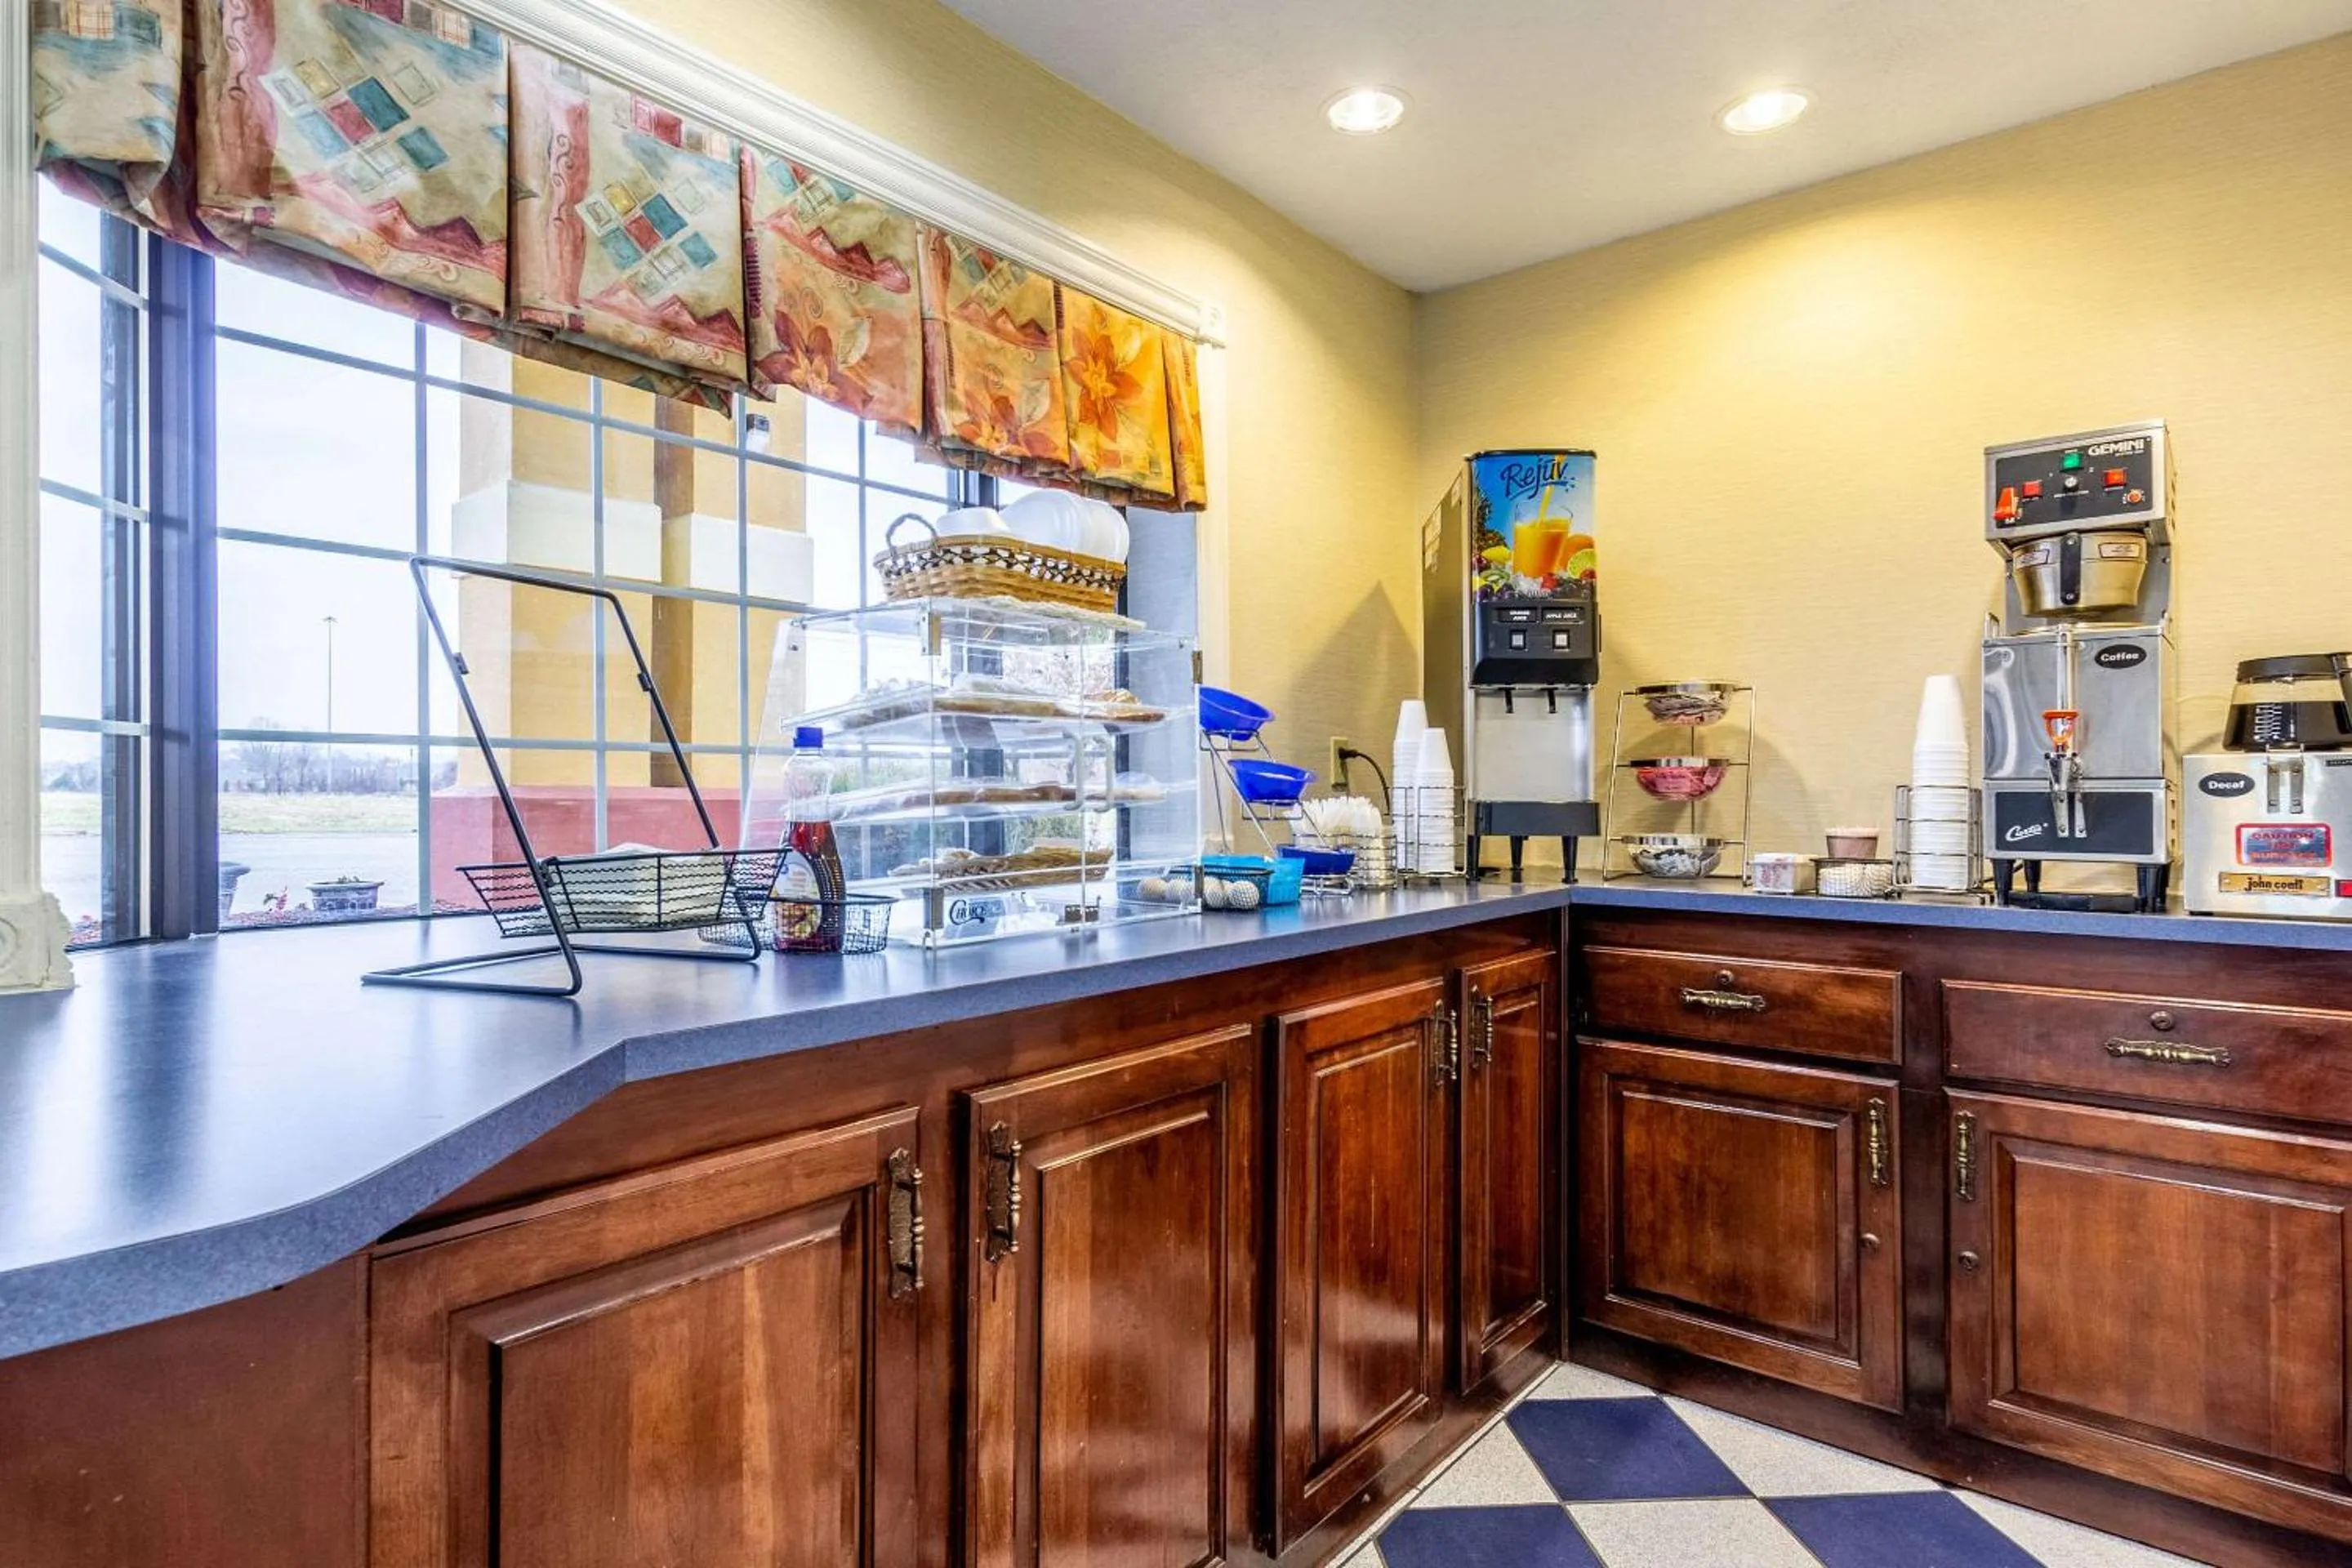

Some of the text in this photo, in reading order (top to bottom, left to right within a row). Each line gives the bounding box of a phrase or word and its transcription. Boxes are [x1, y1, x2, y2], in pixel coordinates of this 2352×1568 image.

[2087, 439, 2145, 456] GEMINI
[2100, 652, 2140, 662] Coffee
[2207, 780, 2246, 790] Decaf
[2252, 831, 2314, 840] CAUTION
[2244, 875, 2273, 892] john
